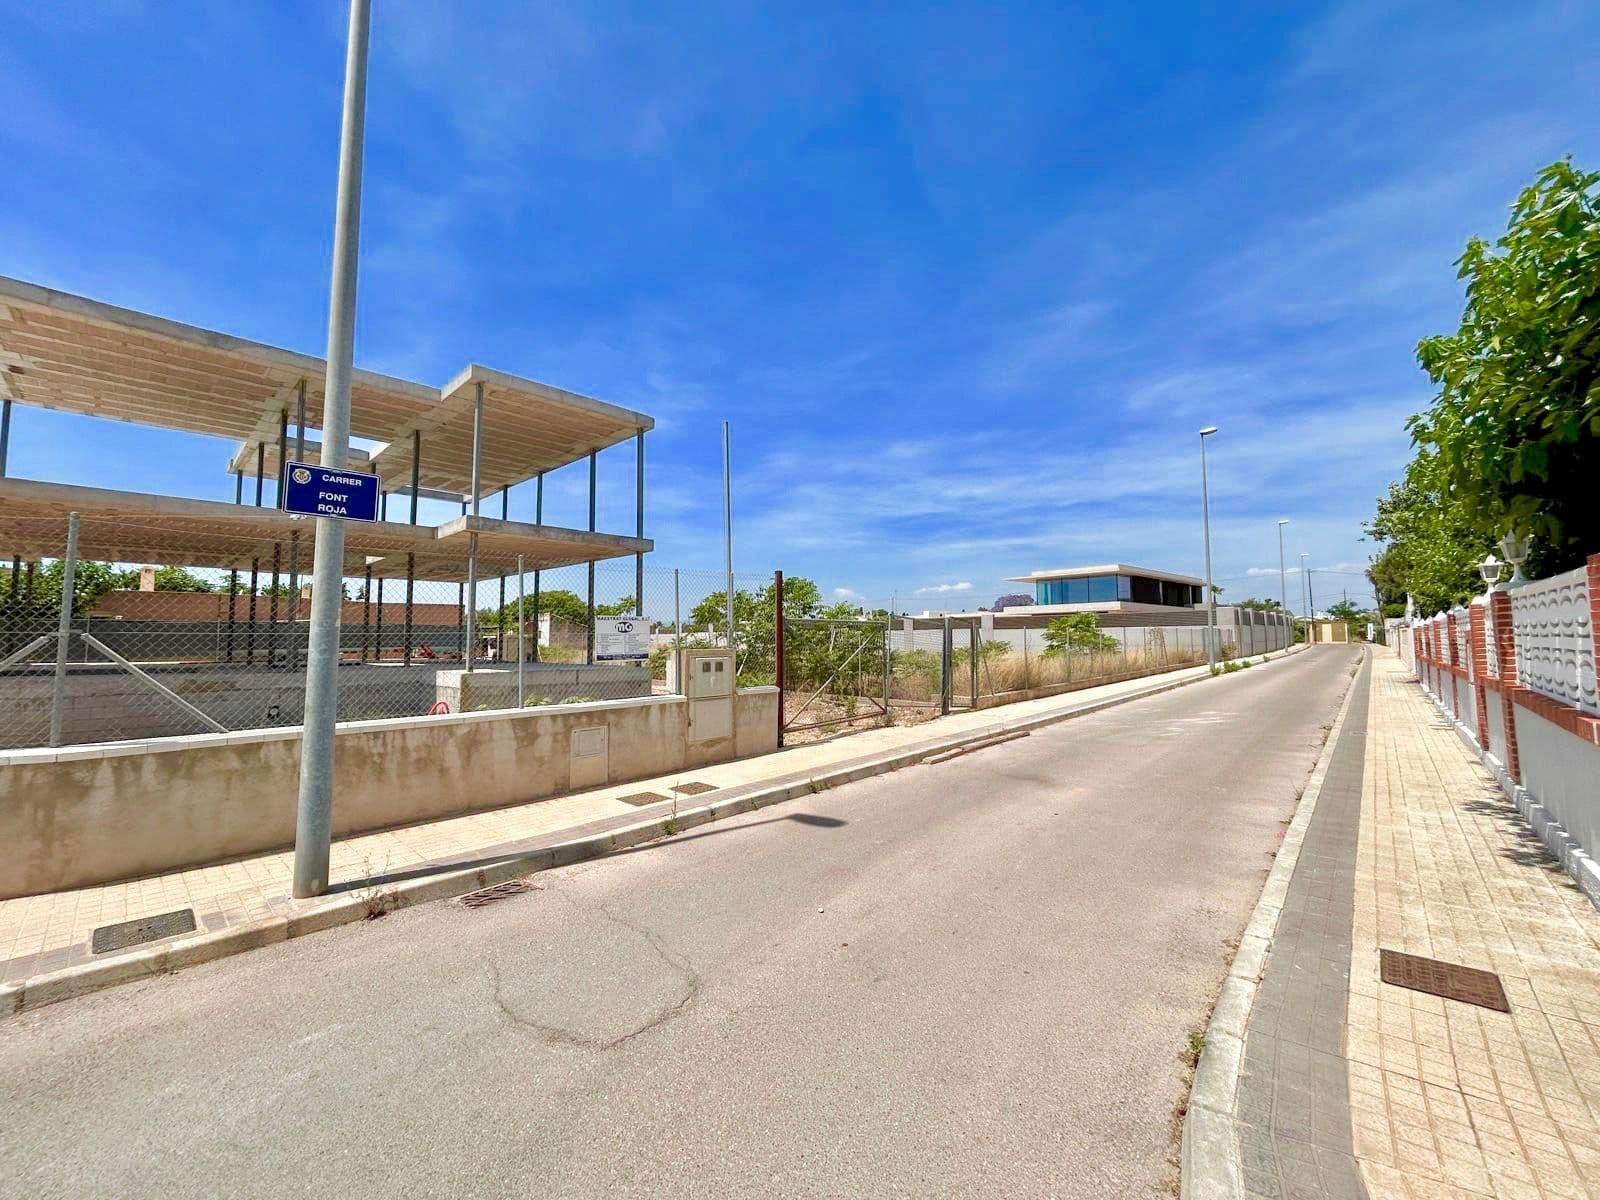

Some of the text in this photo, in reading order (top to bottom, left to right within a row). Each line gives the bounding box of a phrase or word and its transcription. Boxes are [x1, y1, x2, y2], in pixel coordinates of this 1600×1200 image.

[322, 474, 362, 486] CARRER
[319, 491, 348, 503] FONT
[318, 503, 347, 514] ROJA
